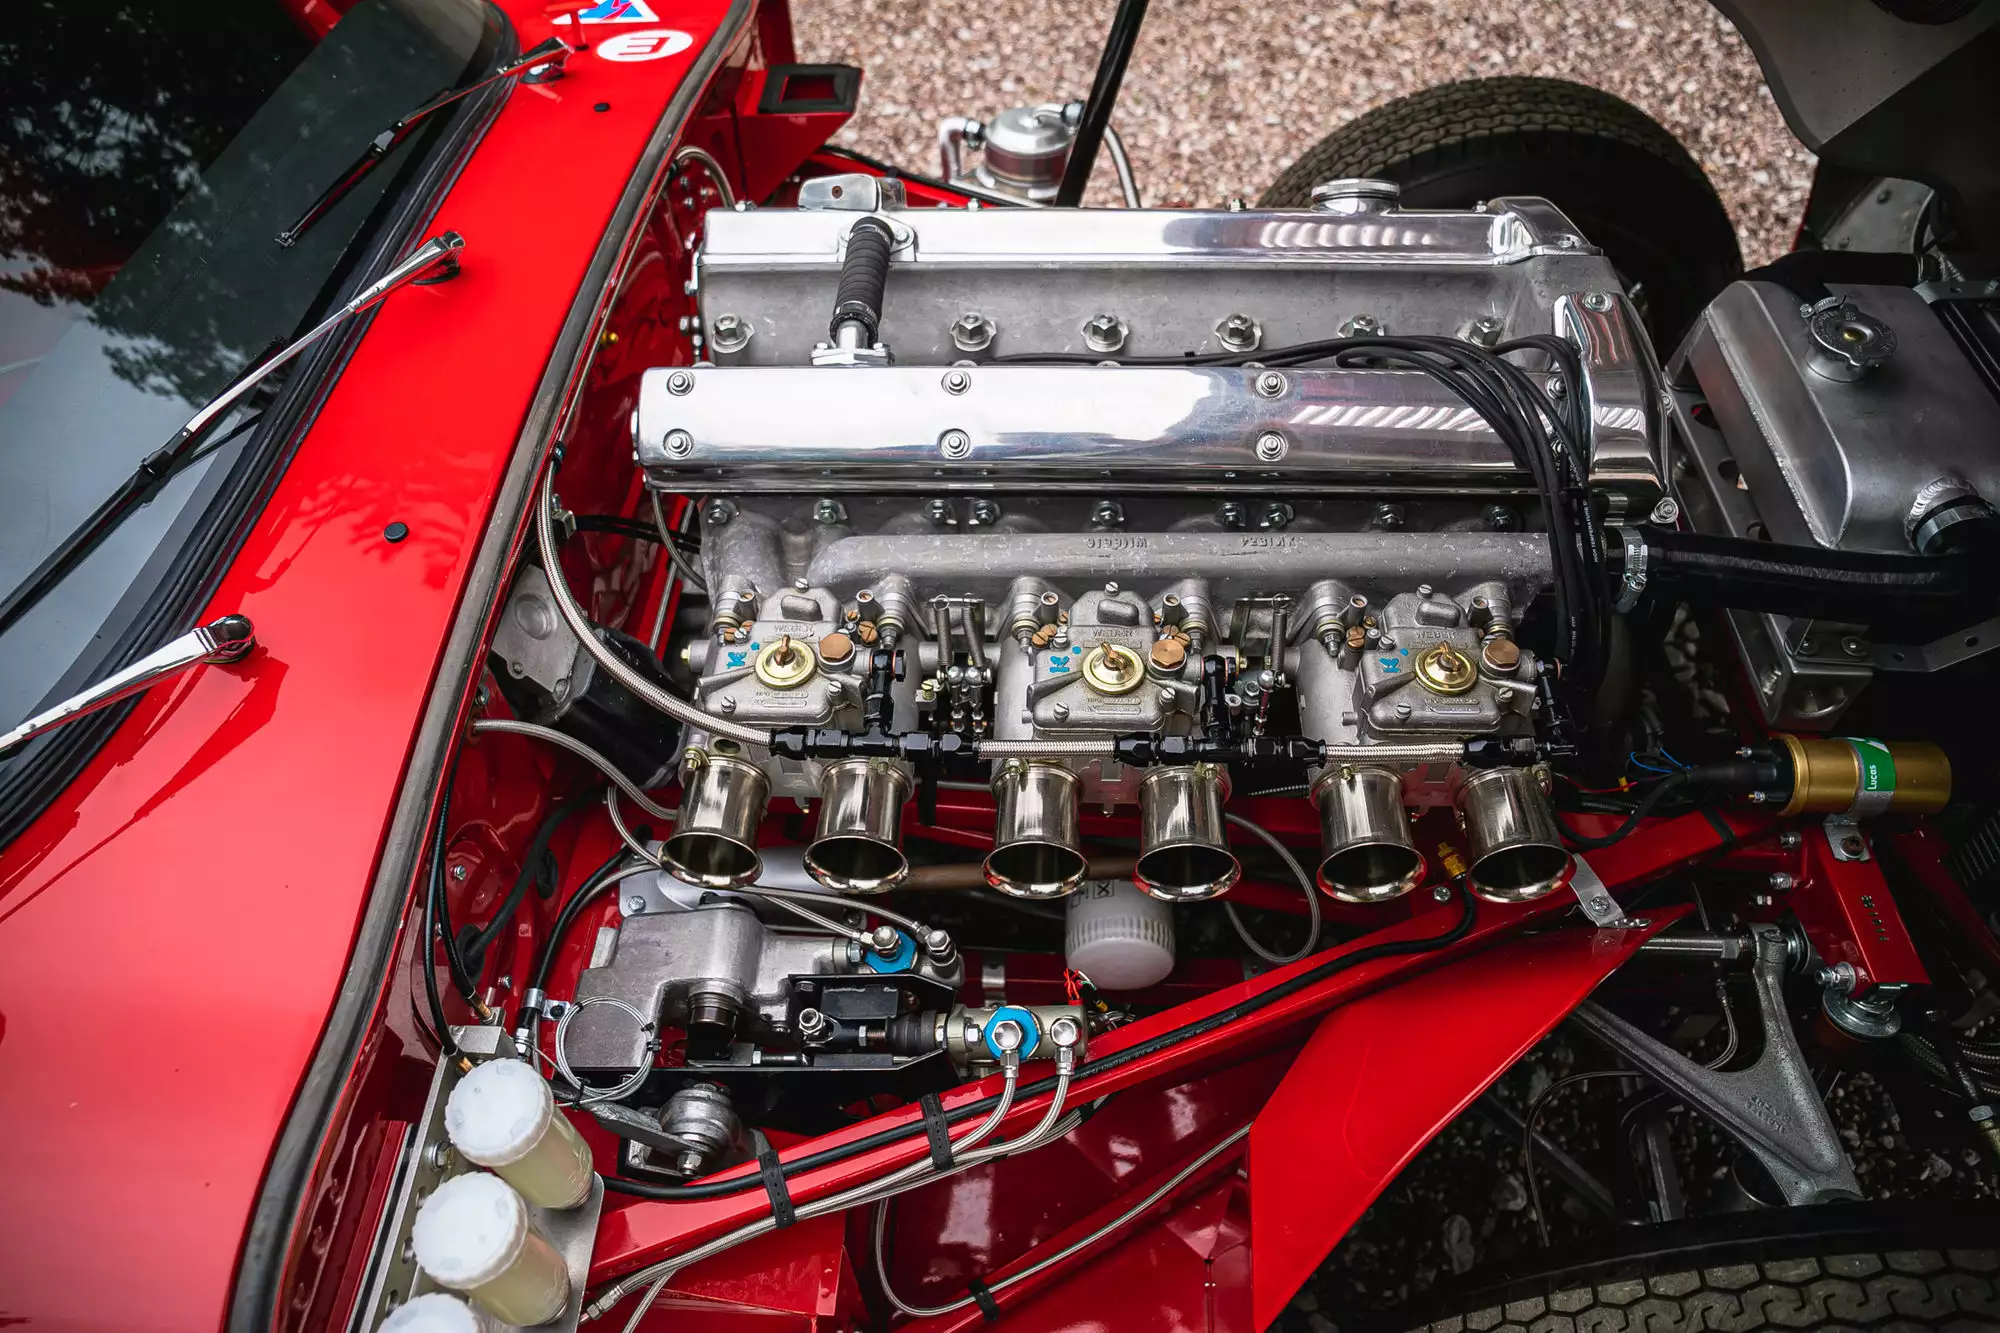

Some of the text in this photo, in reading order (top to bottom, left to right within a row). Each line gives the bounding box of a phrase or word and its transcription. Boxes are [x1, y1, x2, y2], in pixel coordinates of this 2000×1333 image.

[1091, 628, 1133, 638] WEBER
[1414, 630, 1457, 639] WEBER
[1867, 764, 1878, 790] Lucas
